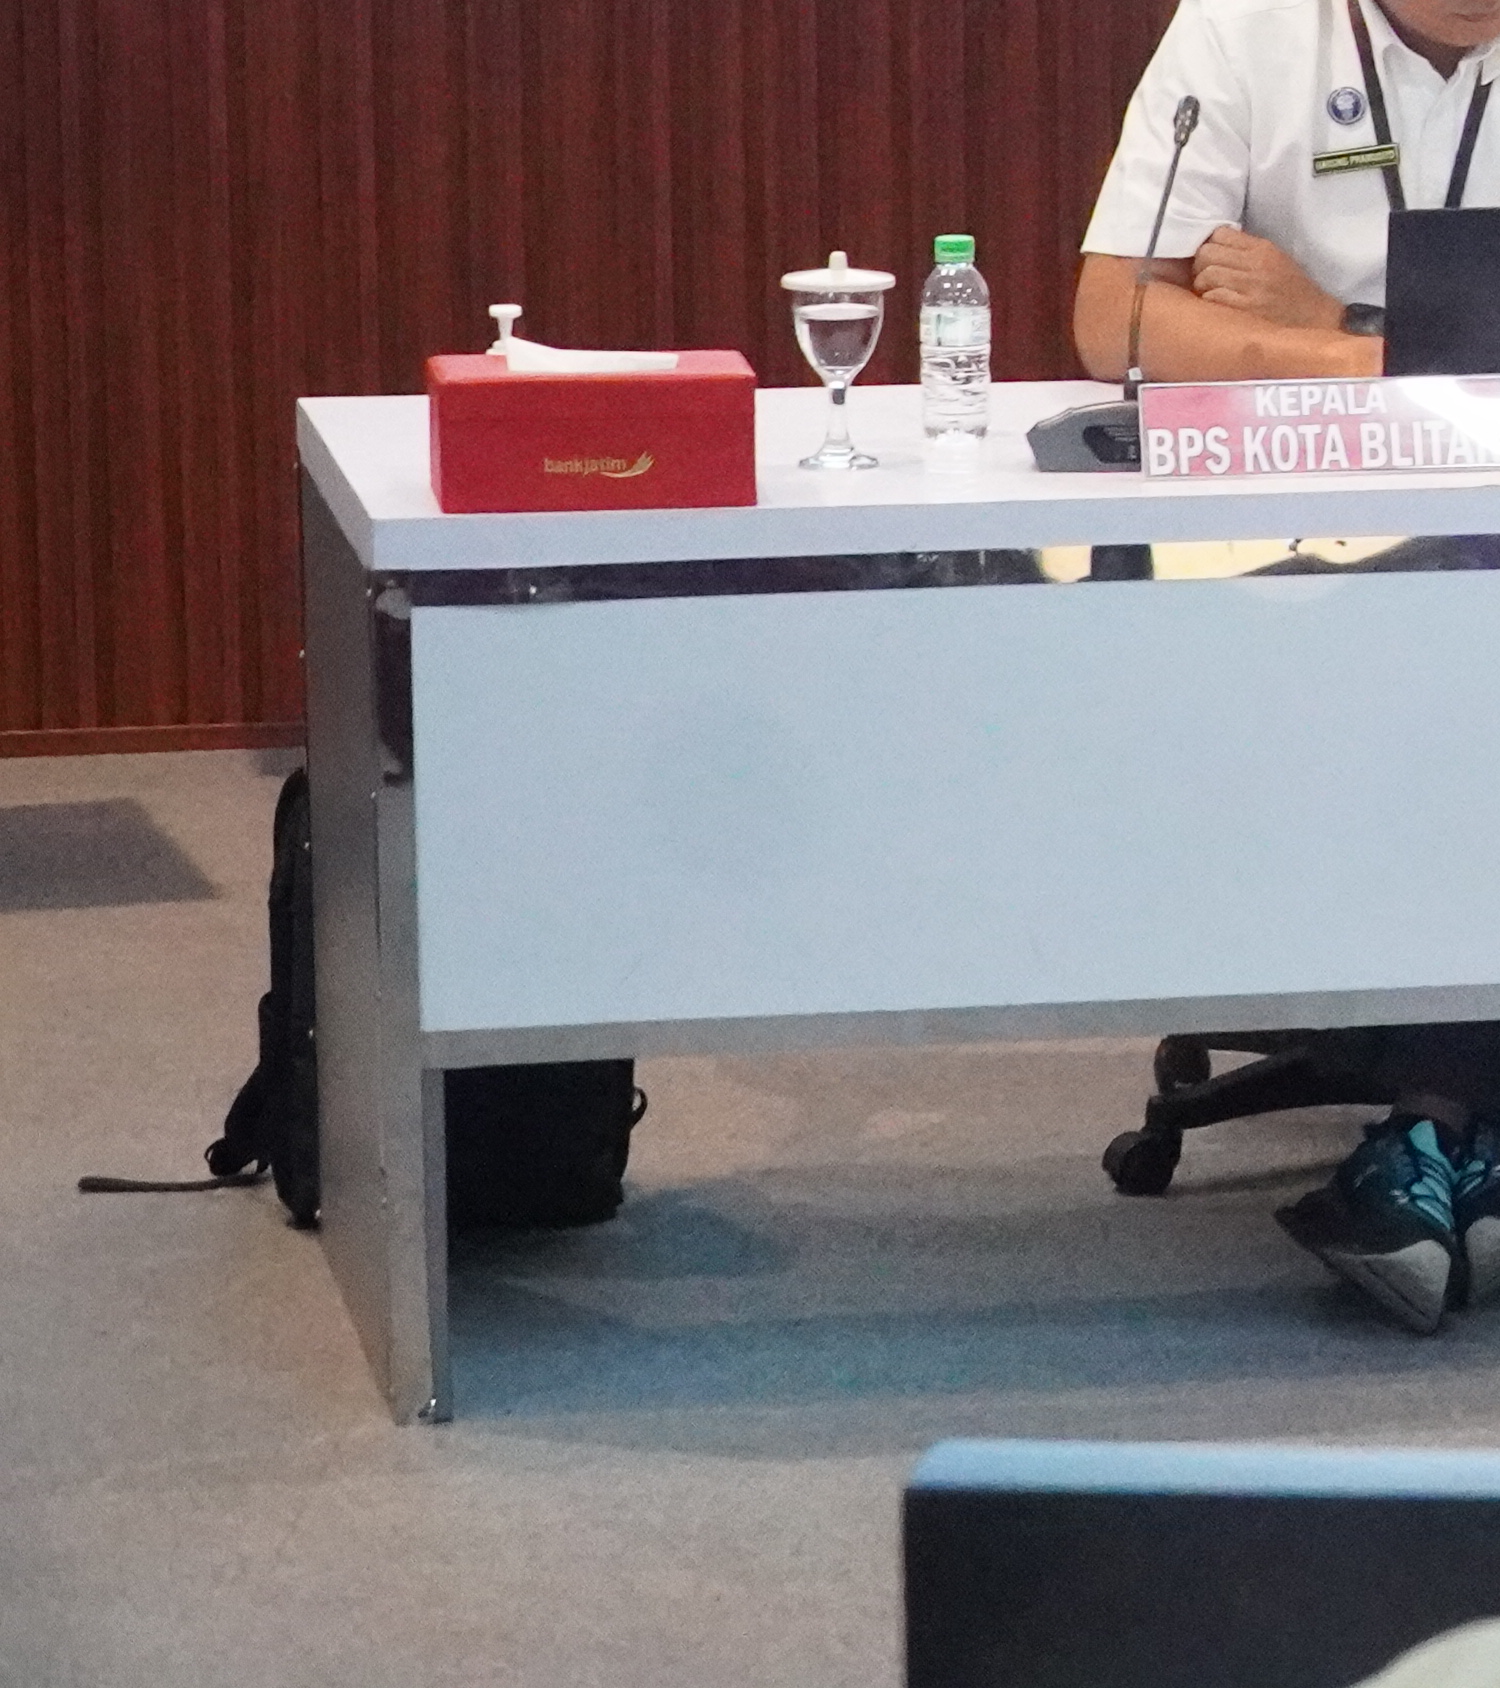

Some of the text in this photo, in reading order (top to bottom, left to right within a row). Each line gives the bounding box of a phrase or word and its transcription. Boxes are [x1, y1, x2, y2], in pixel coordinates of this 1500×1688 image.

[1255, 385, 1388, 419] KEPALA
[1147, 426, 1231, 476] BPS
[1243, 423, 1350, 473] KOTA
